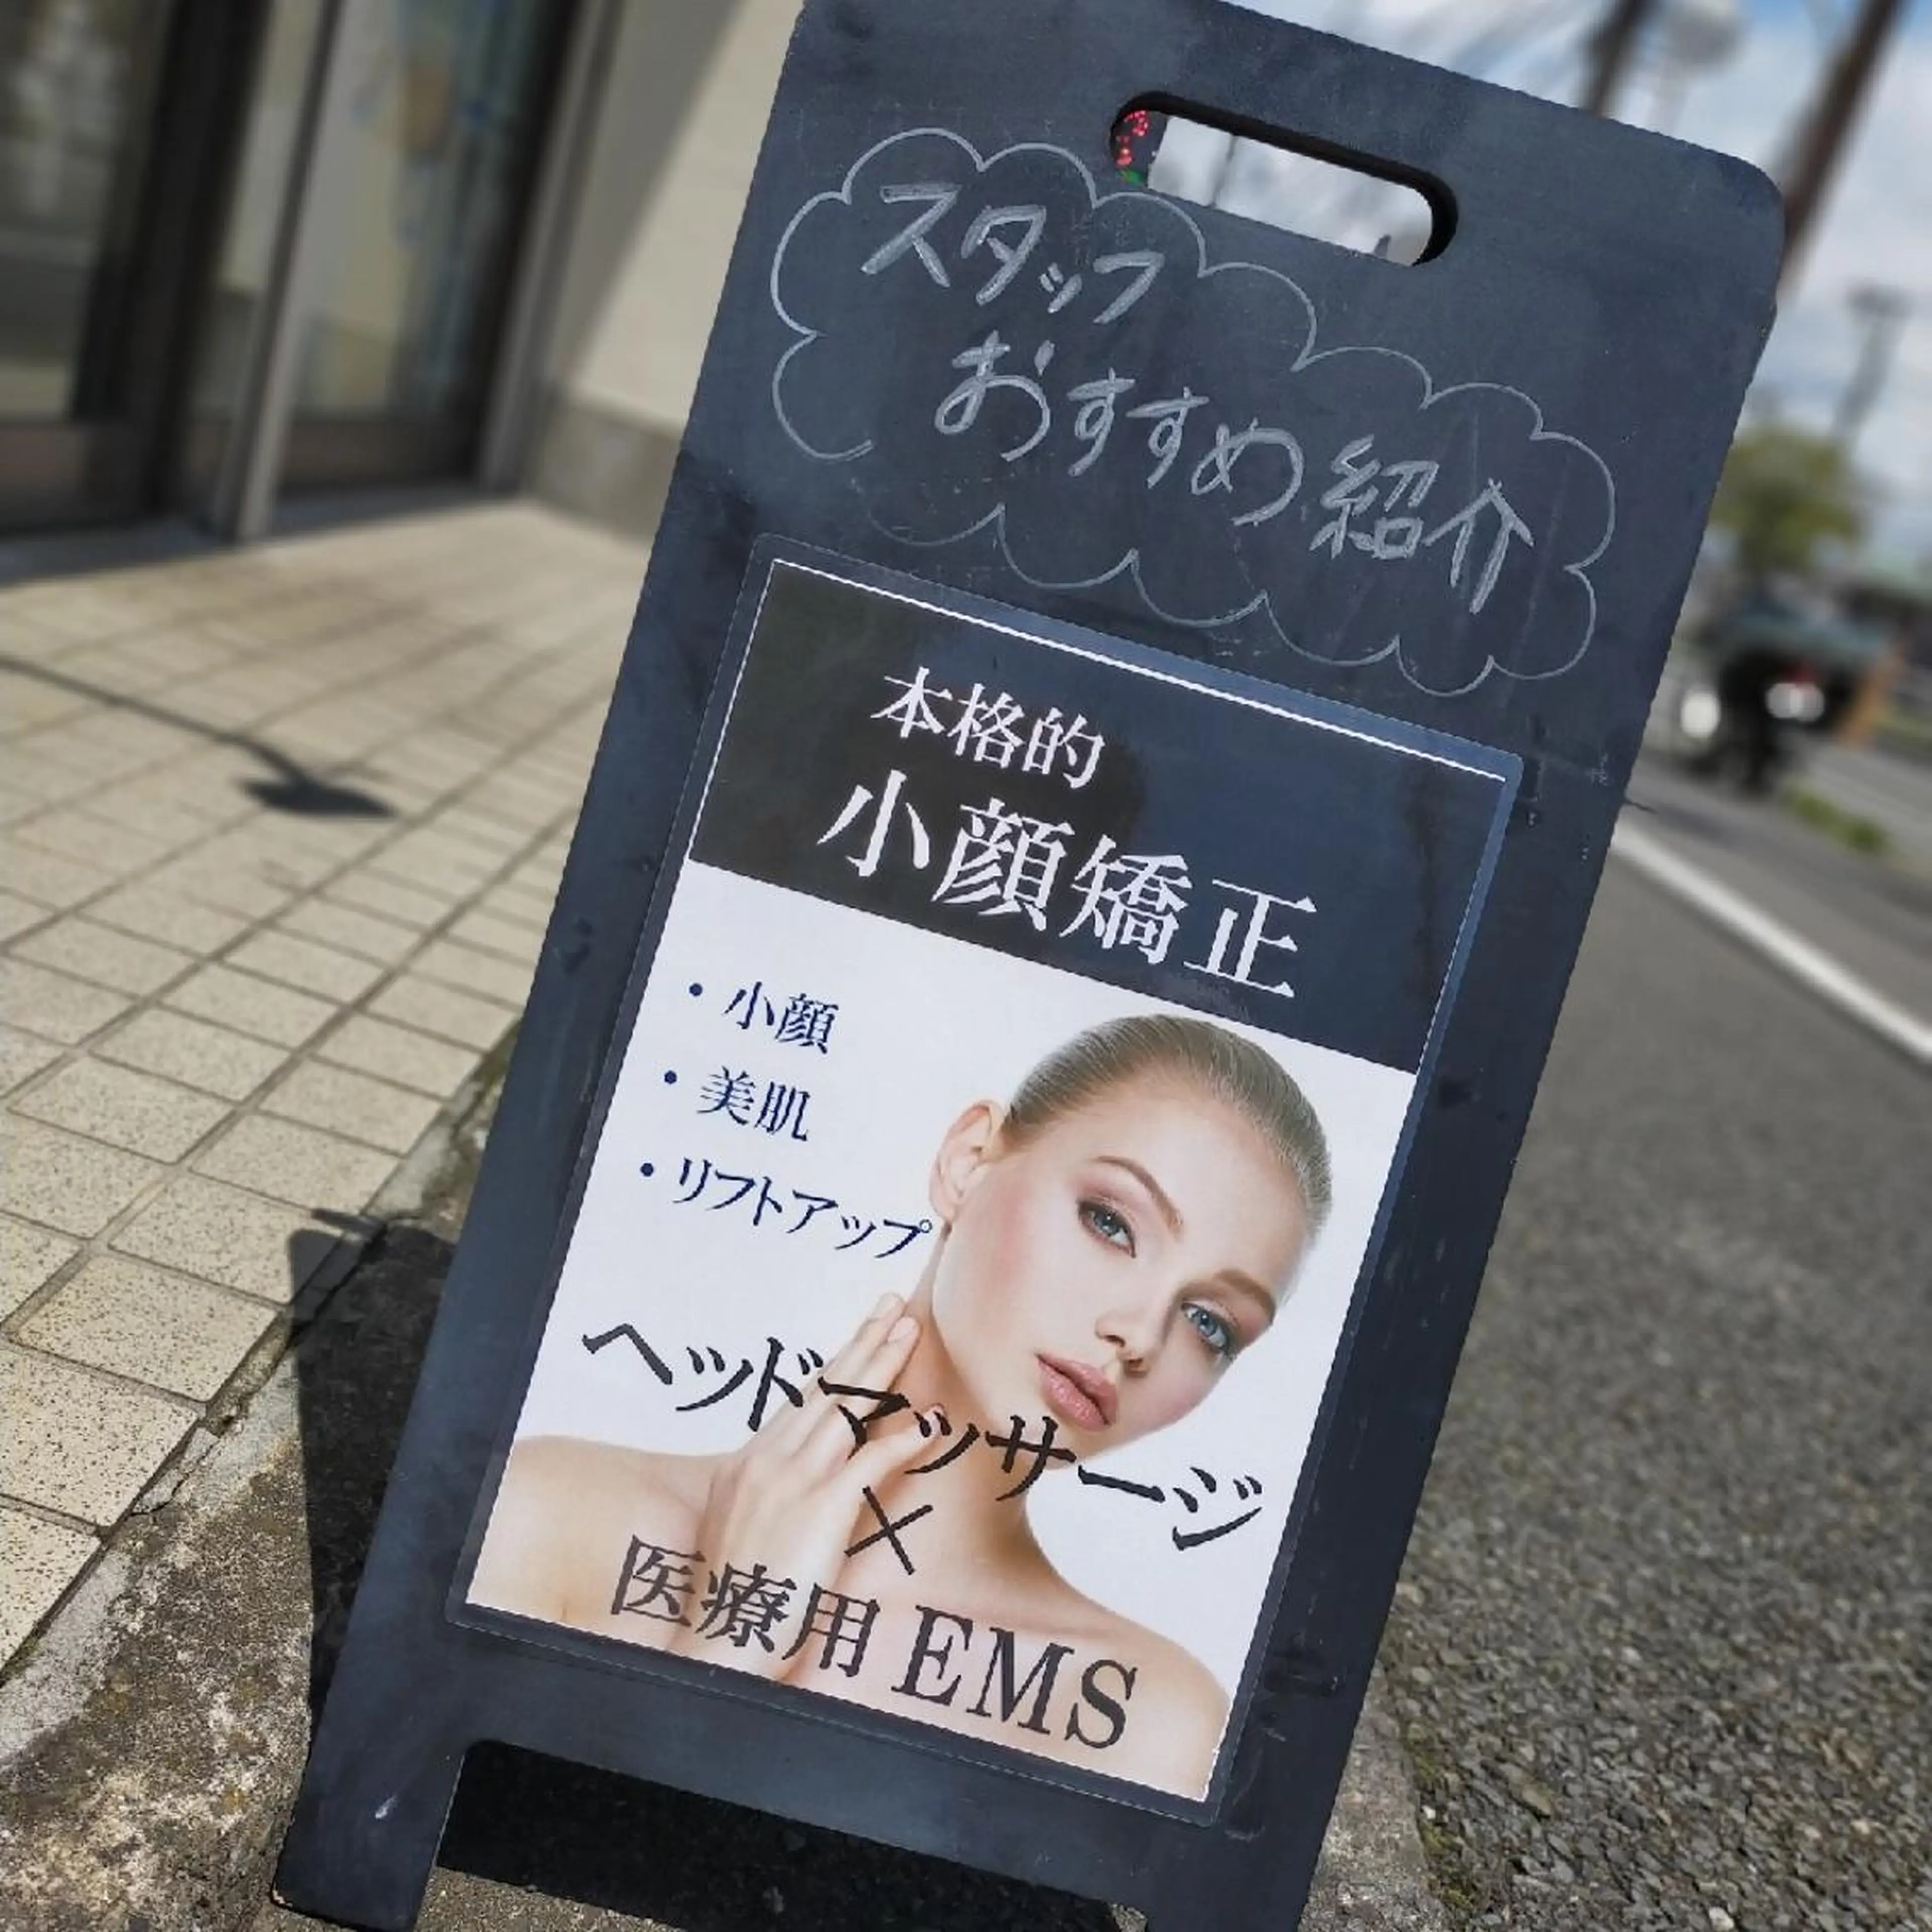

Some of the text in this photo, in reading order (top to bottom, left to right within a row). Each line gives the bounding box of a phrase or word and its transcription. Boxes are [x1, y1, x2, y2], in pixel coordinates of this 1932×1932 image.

[861, 182, 1165, 323] スタッフ
[871, 666, 1105, 789] 本格的
[816, 769, 1317, 998] 小顔矯正
[582, 1323, 1263, 1551] ヘッドマッサージ
